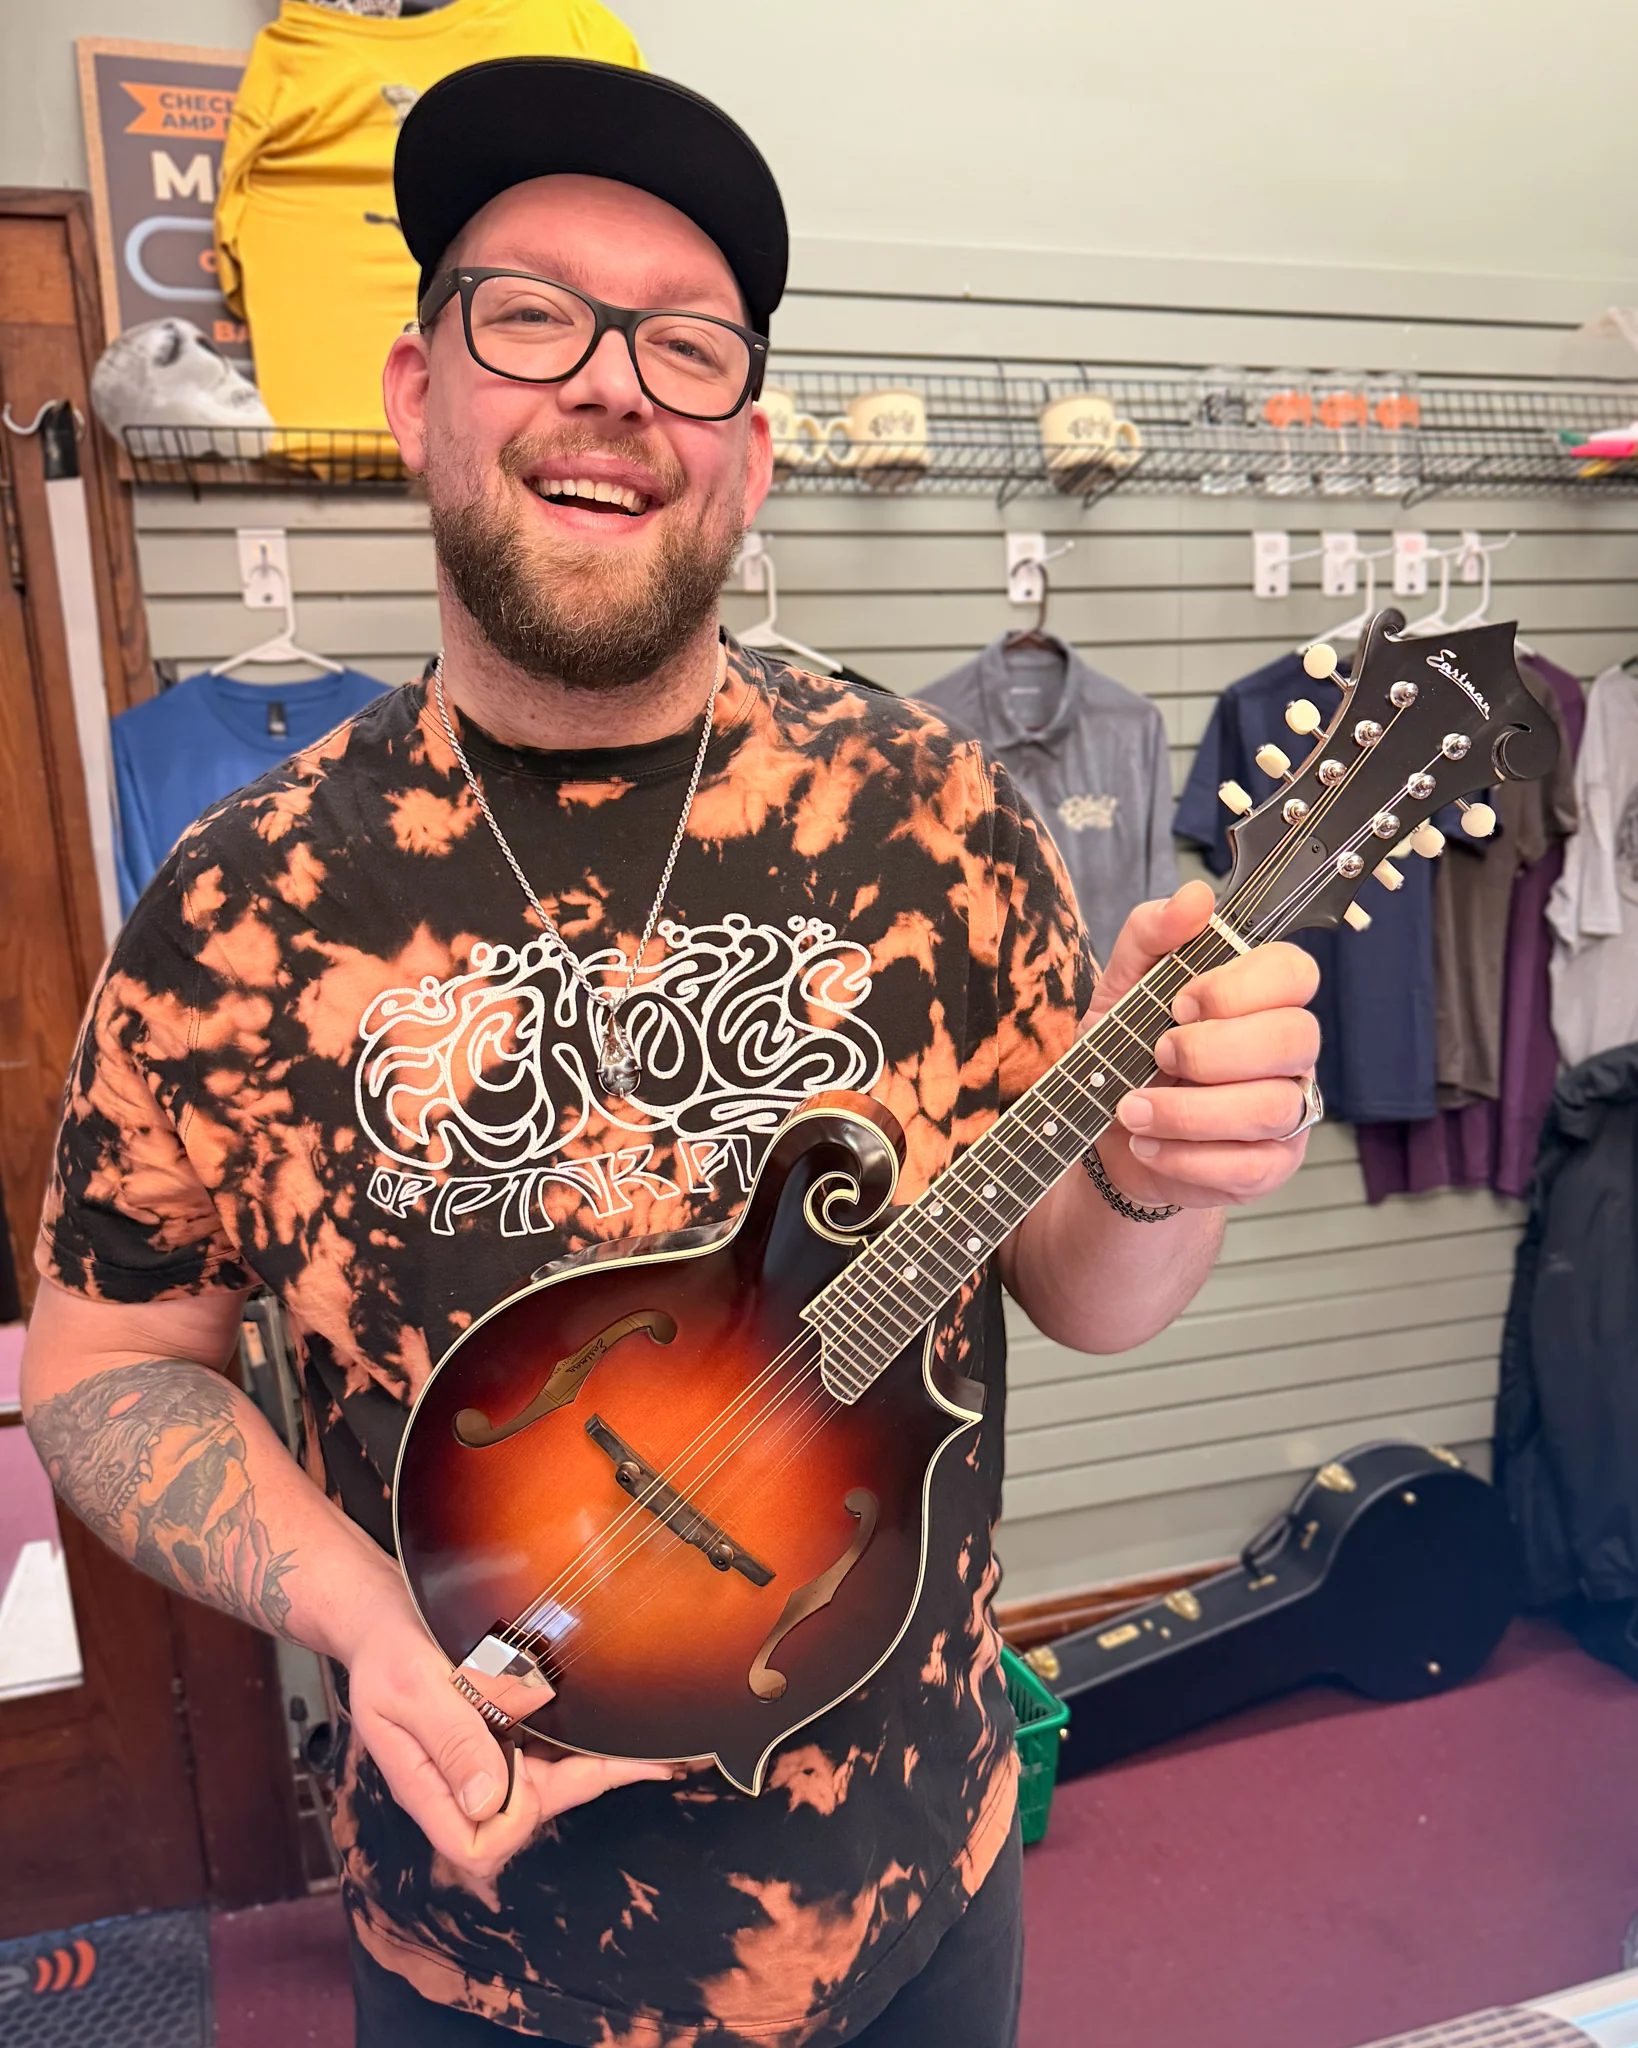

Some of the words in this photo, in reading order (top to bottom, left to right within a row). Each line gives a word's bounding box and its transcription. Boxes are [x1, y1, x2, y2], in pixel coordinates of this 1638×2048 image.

[161, 112, 216, 132] AMP
[1425, 648, 1490, 720] Eastman
[366, 1165, 437, 1219] OF
[430, 1143, 681, 1238] PINK
